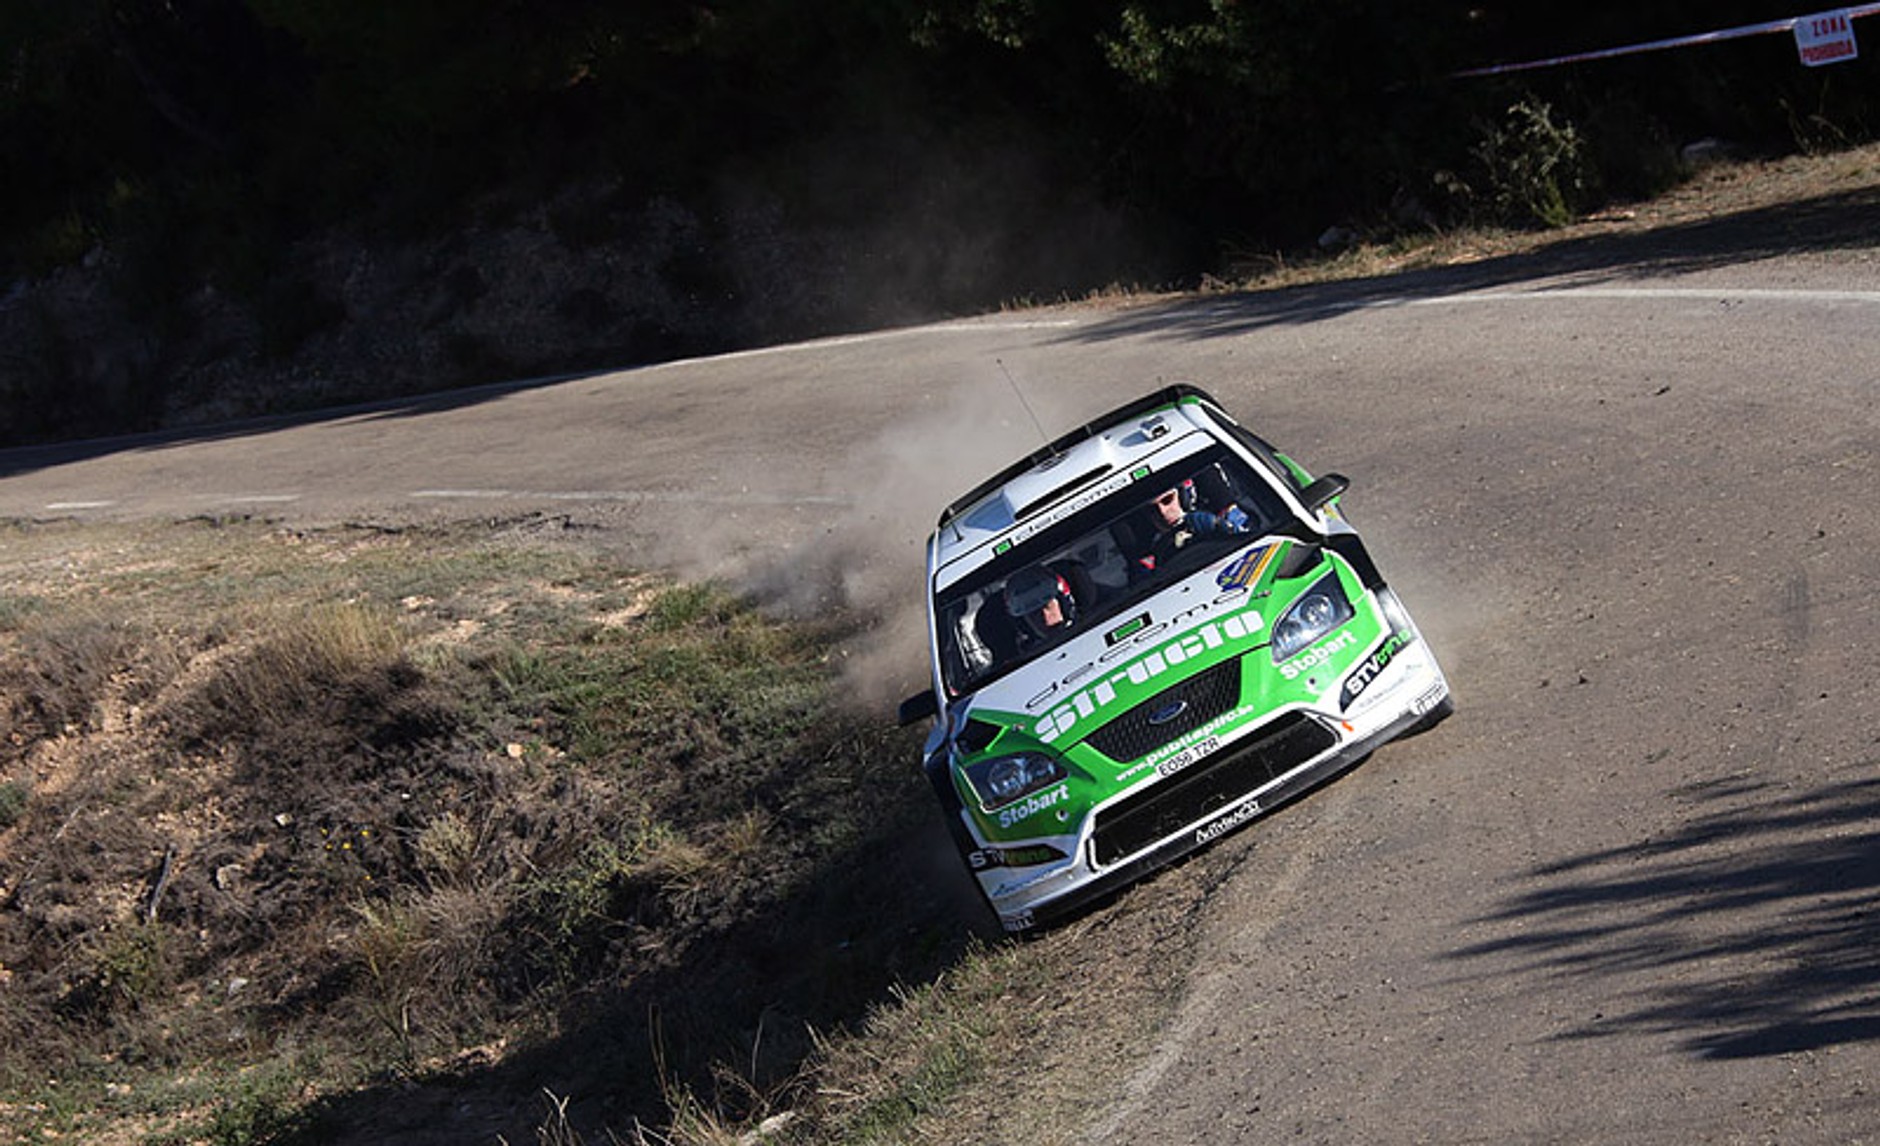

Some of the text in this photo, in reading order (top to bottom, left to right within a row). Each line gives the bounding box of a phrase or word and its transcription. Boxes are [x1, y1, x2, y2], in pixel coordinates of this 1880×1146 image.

[1811, 16, 1847, 37] ZONA
[1280, 630, 1357, 680] Stobart
[1194, 737, 1220, 758] TZR
[999, 784, 1070, 828] Stobart
